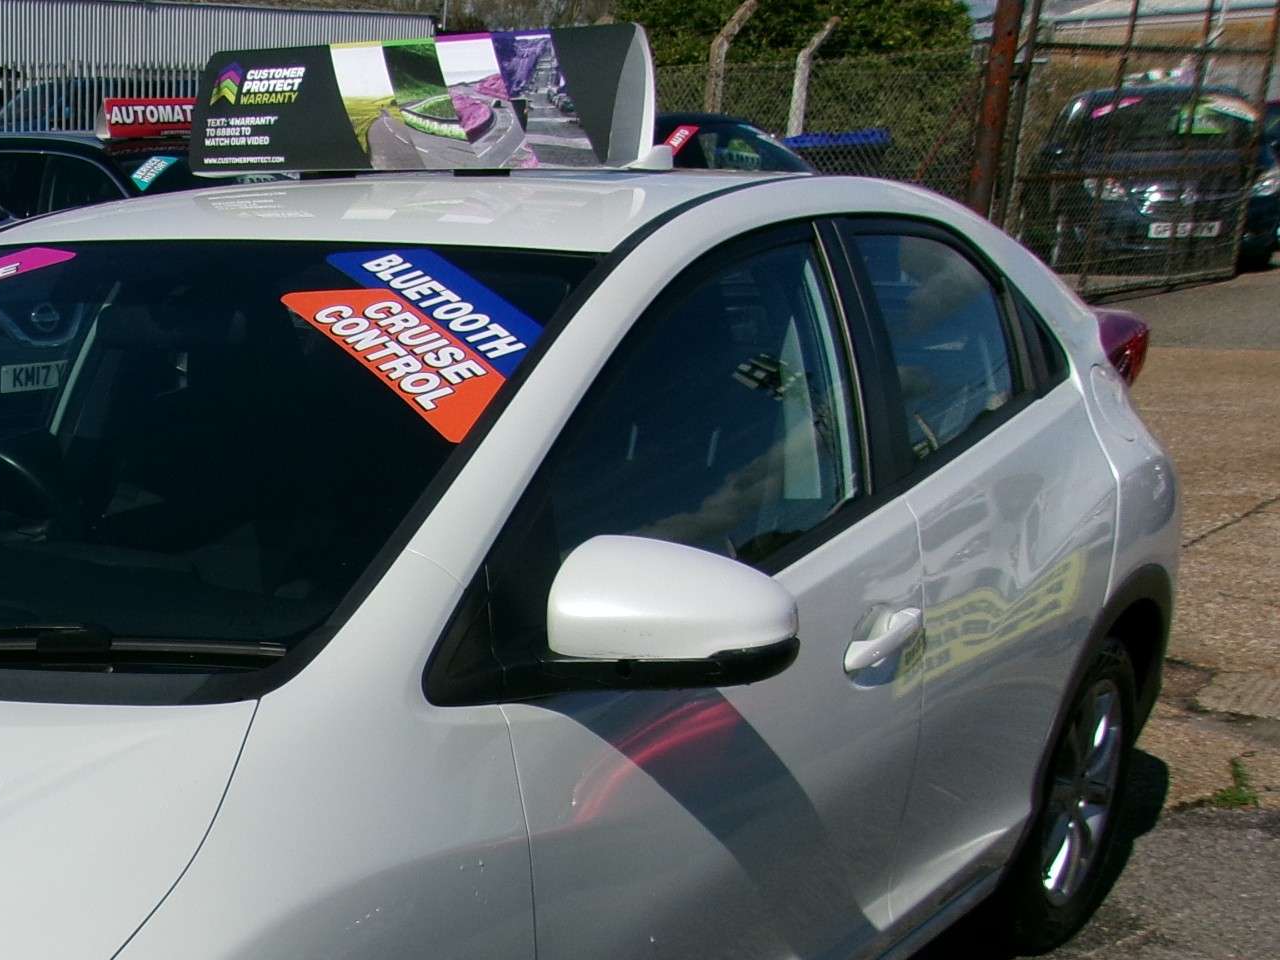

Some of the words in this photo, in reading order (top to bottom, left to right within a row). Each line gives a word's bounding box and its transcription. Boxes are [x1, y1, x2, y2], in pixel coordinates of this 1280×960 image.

[245, 67, 306, 80] CUSTOMER
[242, 78, 303, 93] PROTECT
[240, 92, 299, 105] WARRANTY
[207, 118, 227, 127] TEXT:
[206, 128, 215, 137] TO
[241, 127, 251, 136] TO
[670, 128, 690, 148] AUTO
[205, 138, 230, 147] WATCH
[231, 137, 246, 146] OUR
[247, 136, 270, 145] VIDEO
[361, 253, 527, 359] BLUETOOTH
[363, 300, 488, 385] CRUISE
[314, 305, 456, 412] CONTROL
